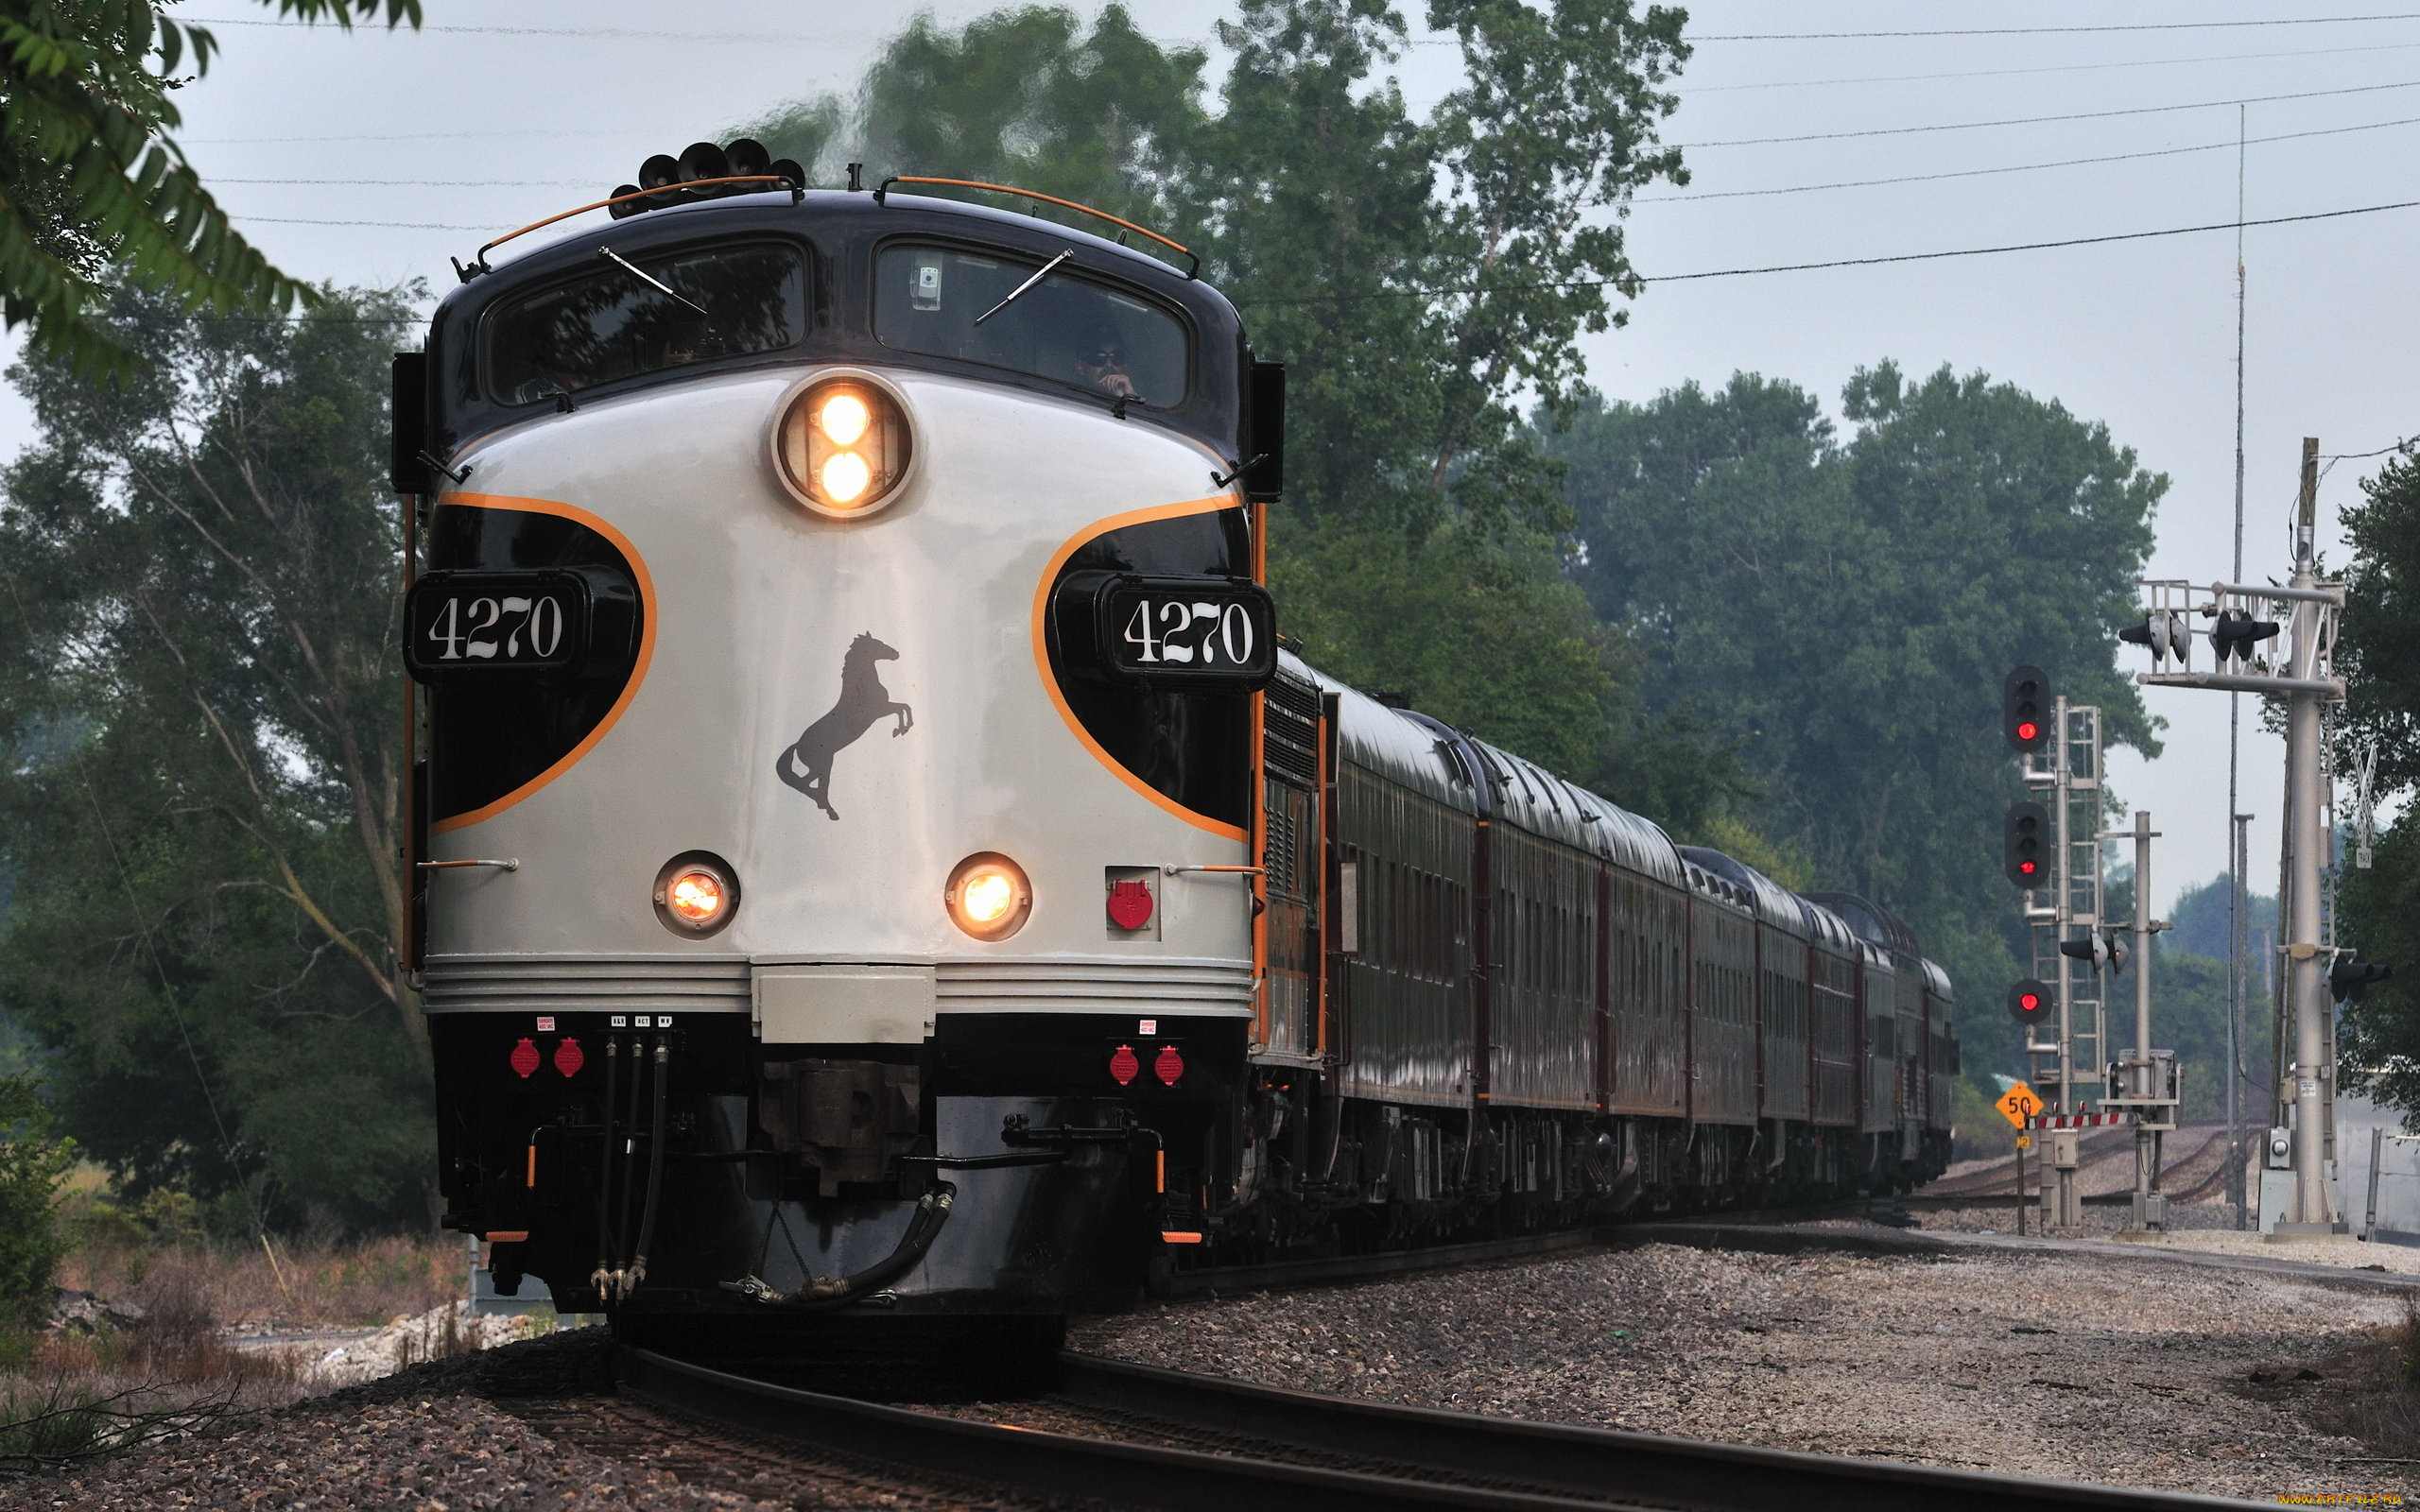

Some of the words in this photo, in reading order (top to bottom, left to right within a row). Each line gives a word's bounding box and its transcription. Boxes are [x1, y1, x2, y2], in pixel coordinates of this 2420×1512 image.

[428, 595, 562, 660] 4270
[1123, 600, 1253, 664] 4270
[2009, 1096, 2031, 1114] 50
